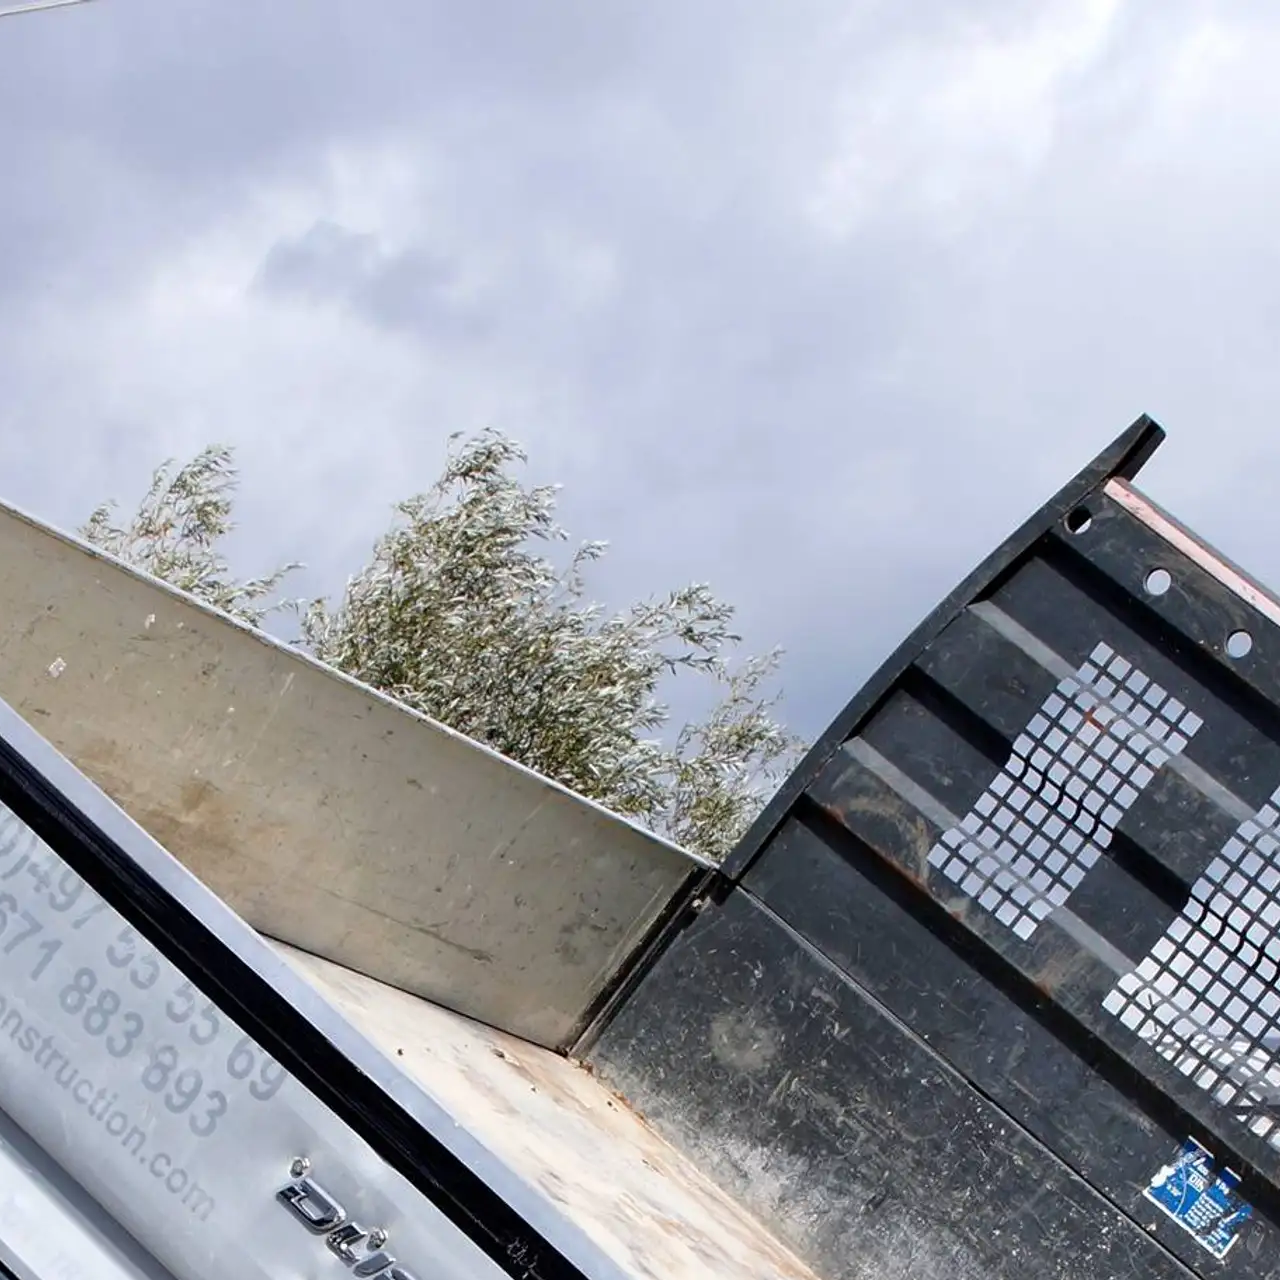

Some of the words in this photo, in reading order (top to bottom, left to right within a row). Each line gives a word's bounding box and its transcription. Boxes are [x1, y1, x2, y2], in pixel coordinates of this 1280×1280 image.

[58, 967, 144, 1058] 883
[141, 1045, 228, 1138] 893
[227, 1036, 288, 1101] 69
